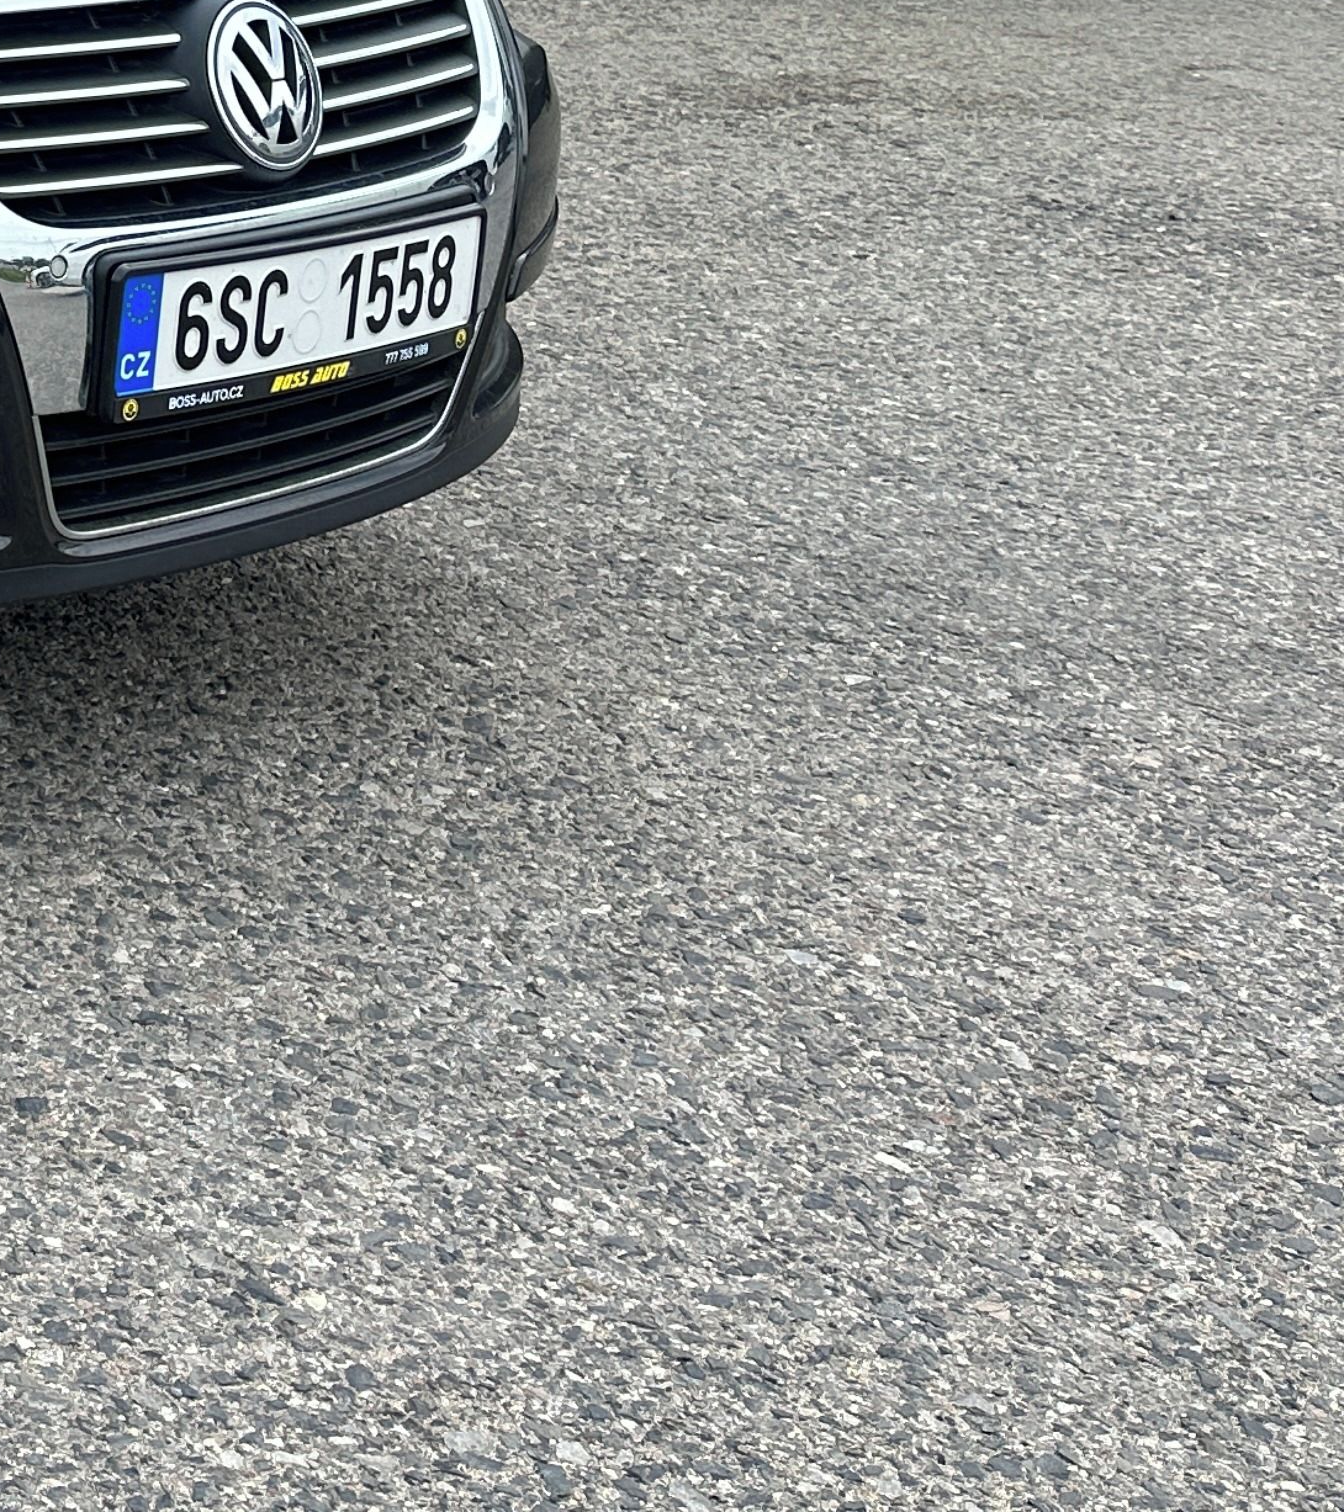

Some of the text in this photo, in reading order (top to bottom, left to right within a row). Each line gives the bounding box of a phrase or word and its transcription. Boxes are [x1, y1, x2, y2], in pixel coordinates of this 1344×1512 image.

[174, 234, 456, 372] 6SC 1558
[120, 350, 149, 380] CZ
[168, 385, 244, 410] BOSS-AUTO.CZ
[270, 370, 310, 394] BOSS
[310, 360, 351, 385] AUTO
